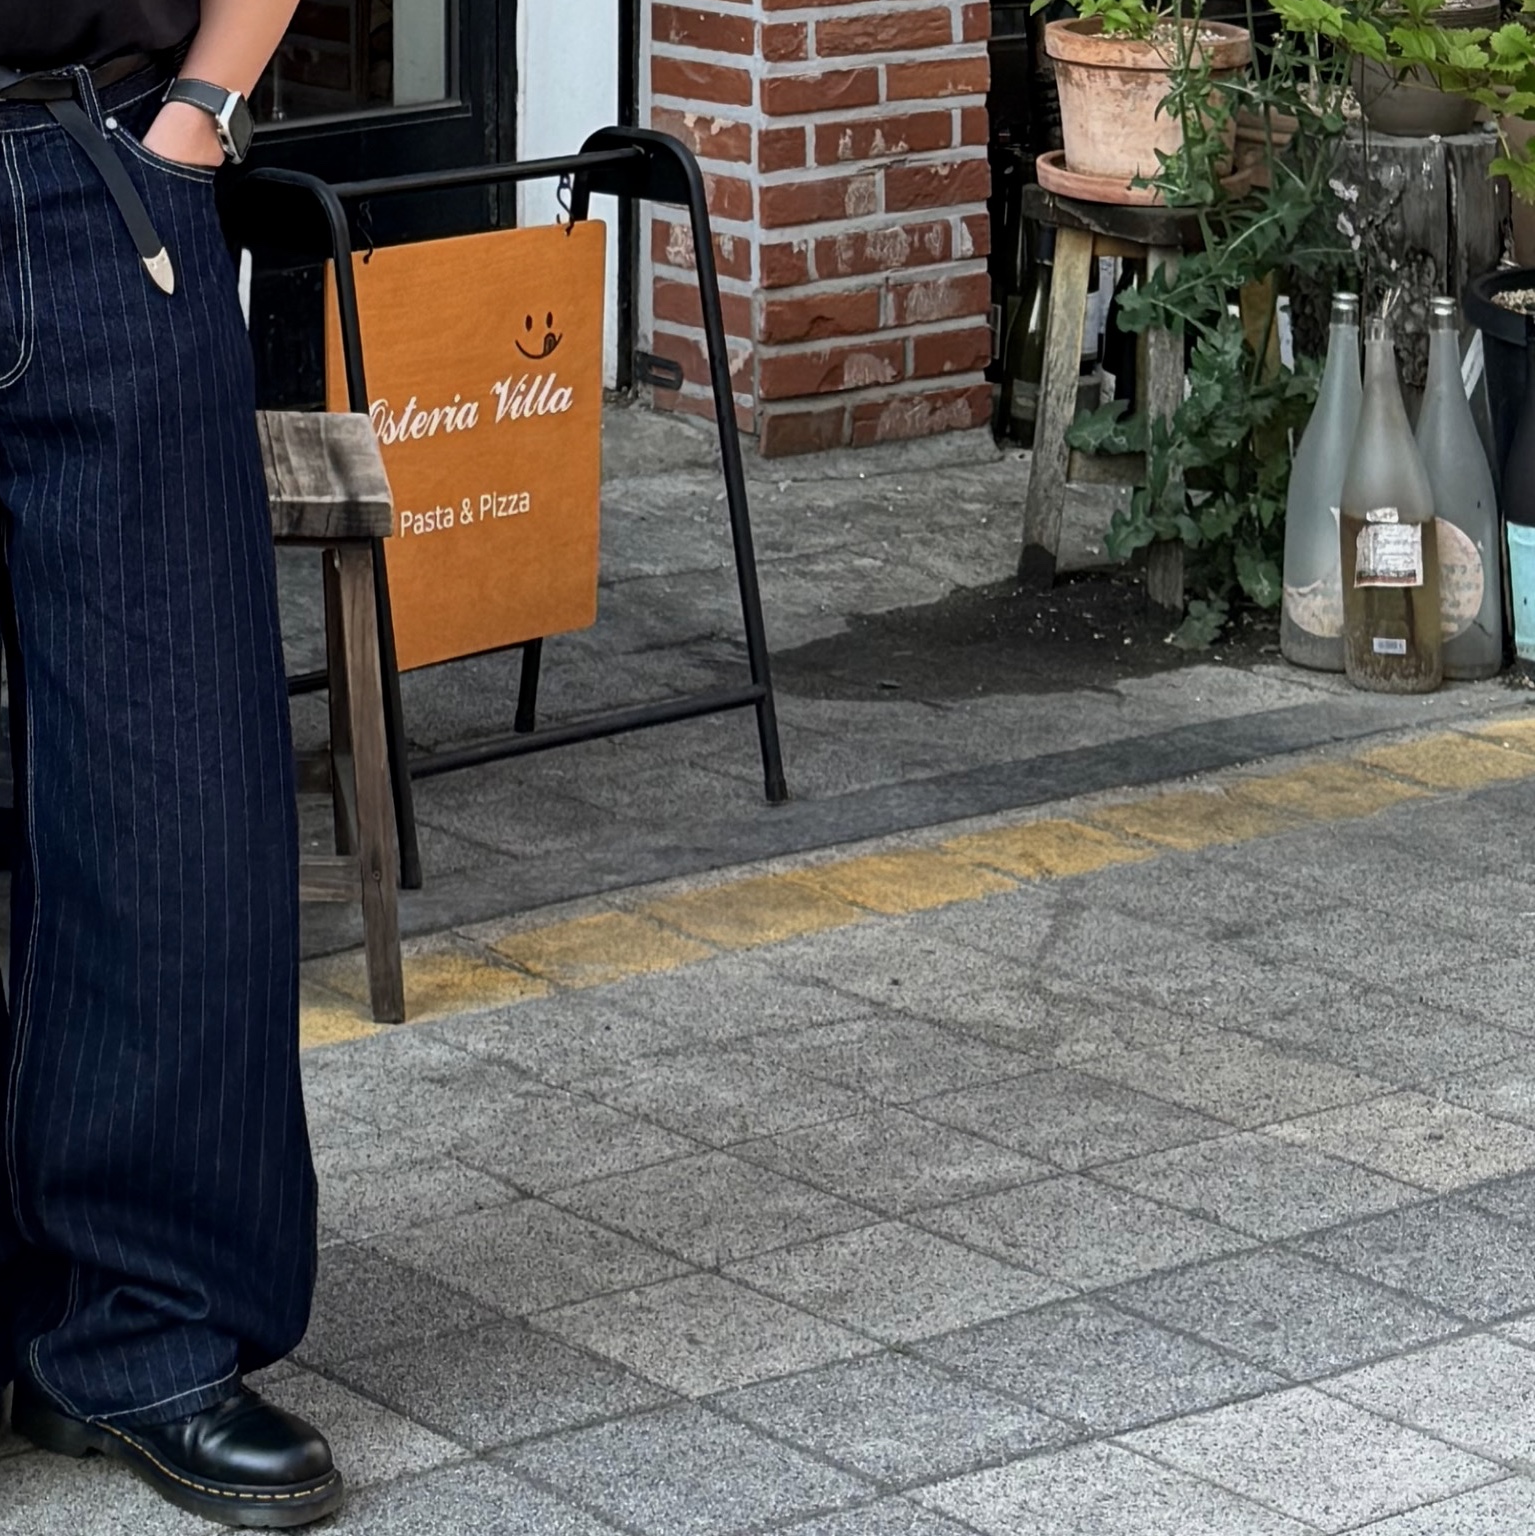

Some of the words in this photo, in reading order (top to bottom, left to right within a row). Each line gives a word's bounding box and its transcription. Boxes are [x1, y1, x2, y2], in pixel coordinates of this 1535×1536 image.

[490, 372, 573, 424] Villa
[400, 505, 454, 538] Pasta
[459, 498, 474, 525] &
[479, 491, 530, 521] Pizza
